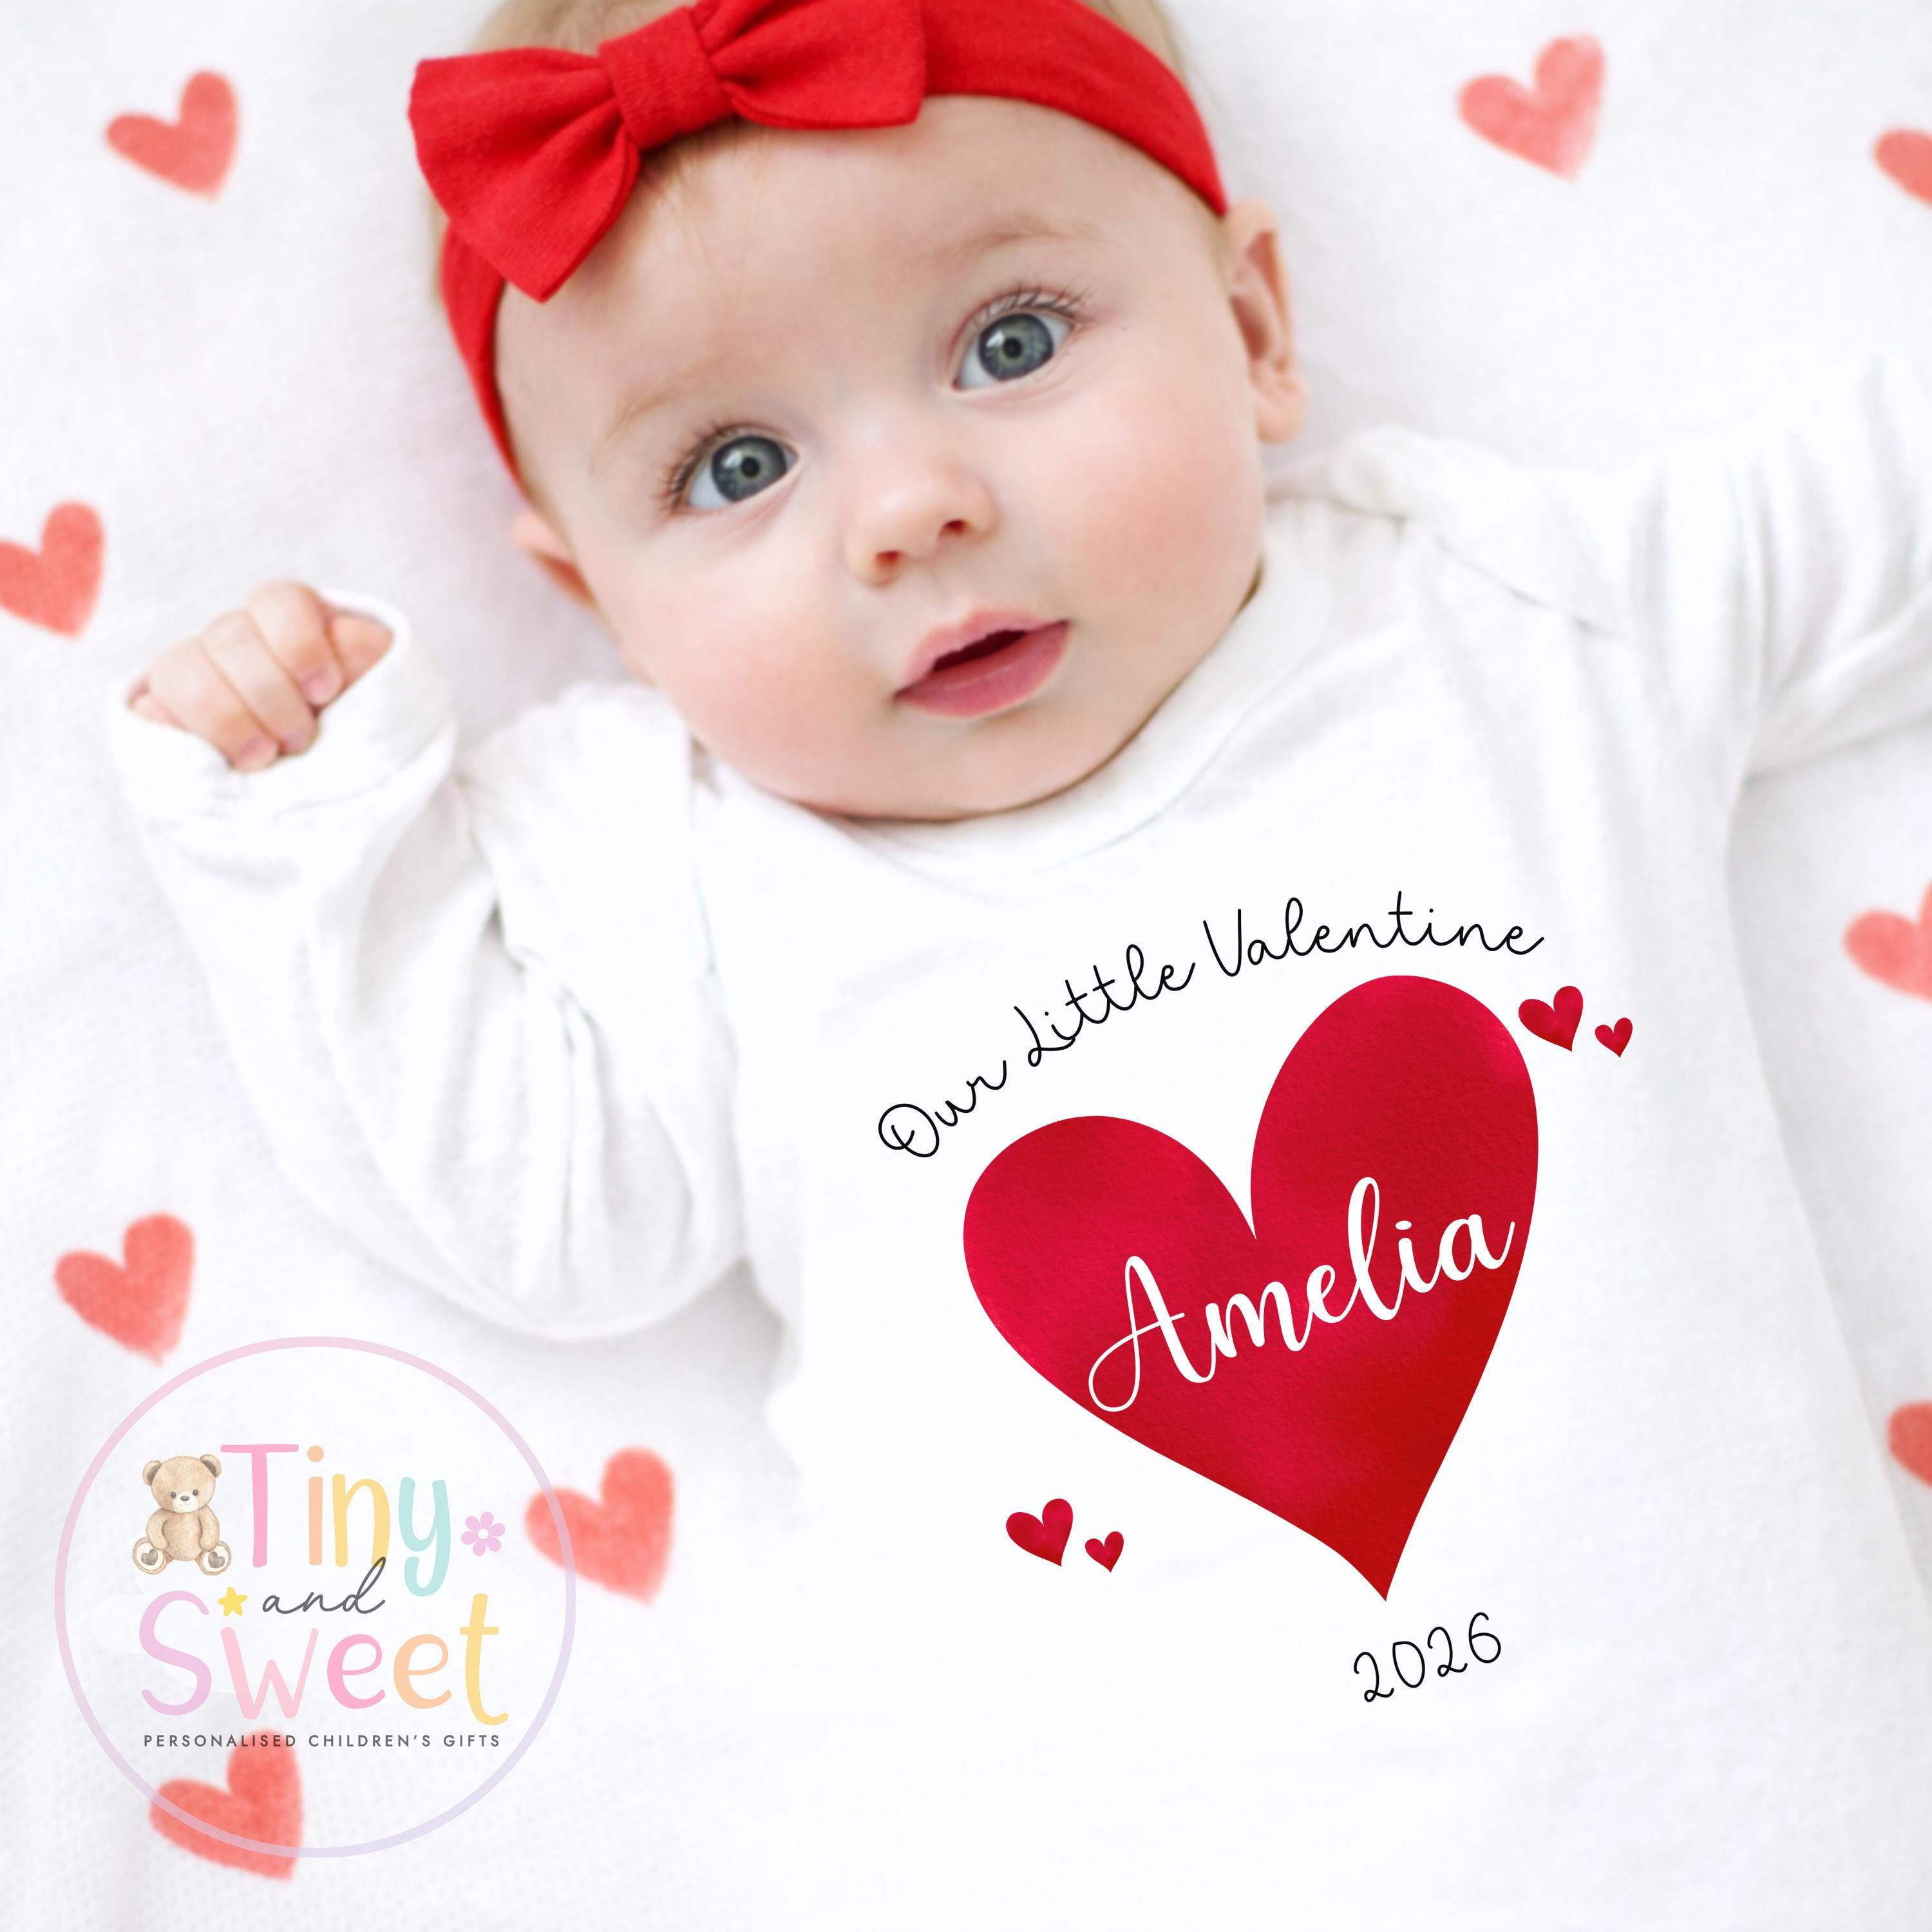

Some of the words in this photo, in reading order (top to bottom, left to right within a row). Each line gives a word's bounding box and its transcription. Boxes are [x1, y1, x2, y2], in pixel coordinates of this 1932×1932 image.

[878, 1059, 1007, 1158] Our
[1014, 943, 1196, 1068] Little
[1202, 890, 1545, 977] Valentine
[1088, 1176, 1516, 1413] Amelia
[1353, 1612, 1502, 1703] 2026
